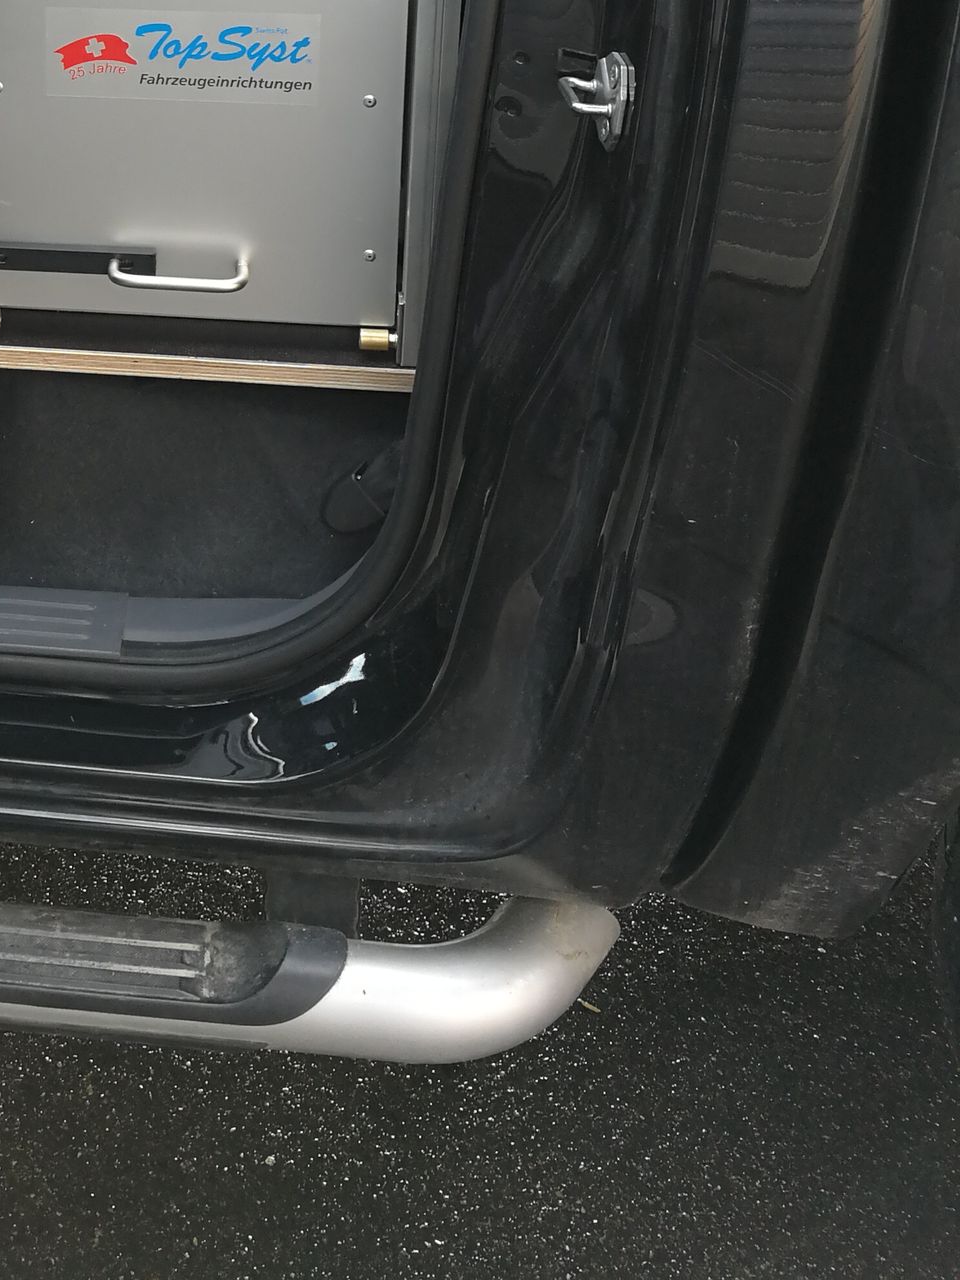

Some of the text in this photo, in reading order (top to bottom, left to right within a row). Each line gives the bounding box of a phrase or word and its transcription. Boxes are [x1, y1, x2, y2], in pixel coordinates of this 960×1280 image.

[68, 62, 127, 80] 25 Jahre
[139, 73, 312, 94] Fahrzeugeinrichtungen
